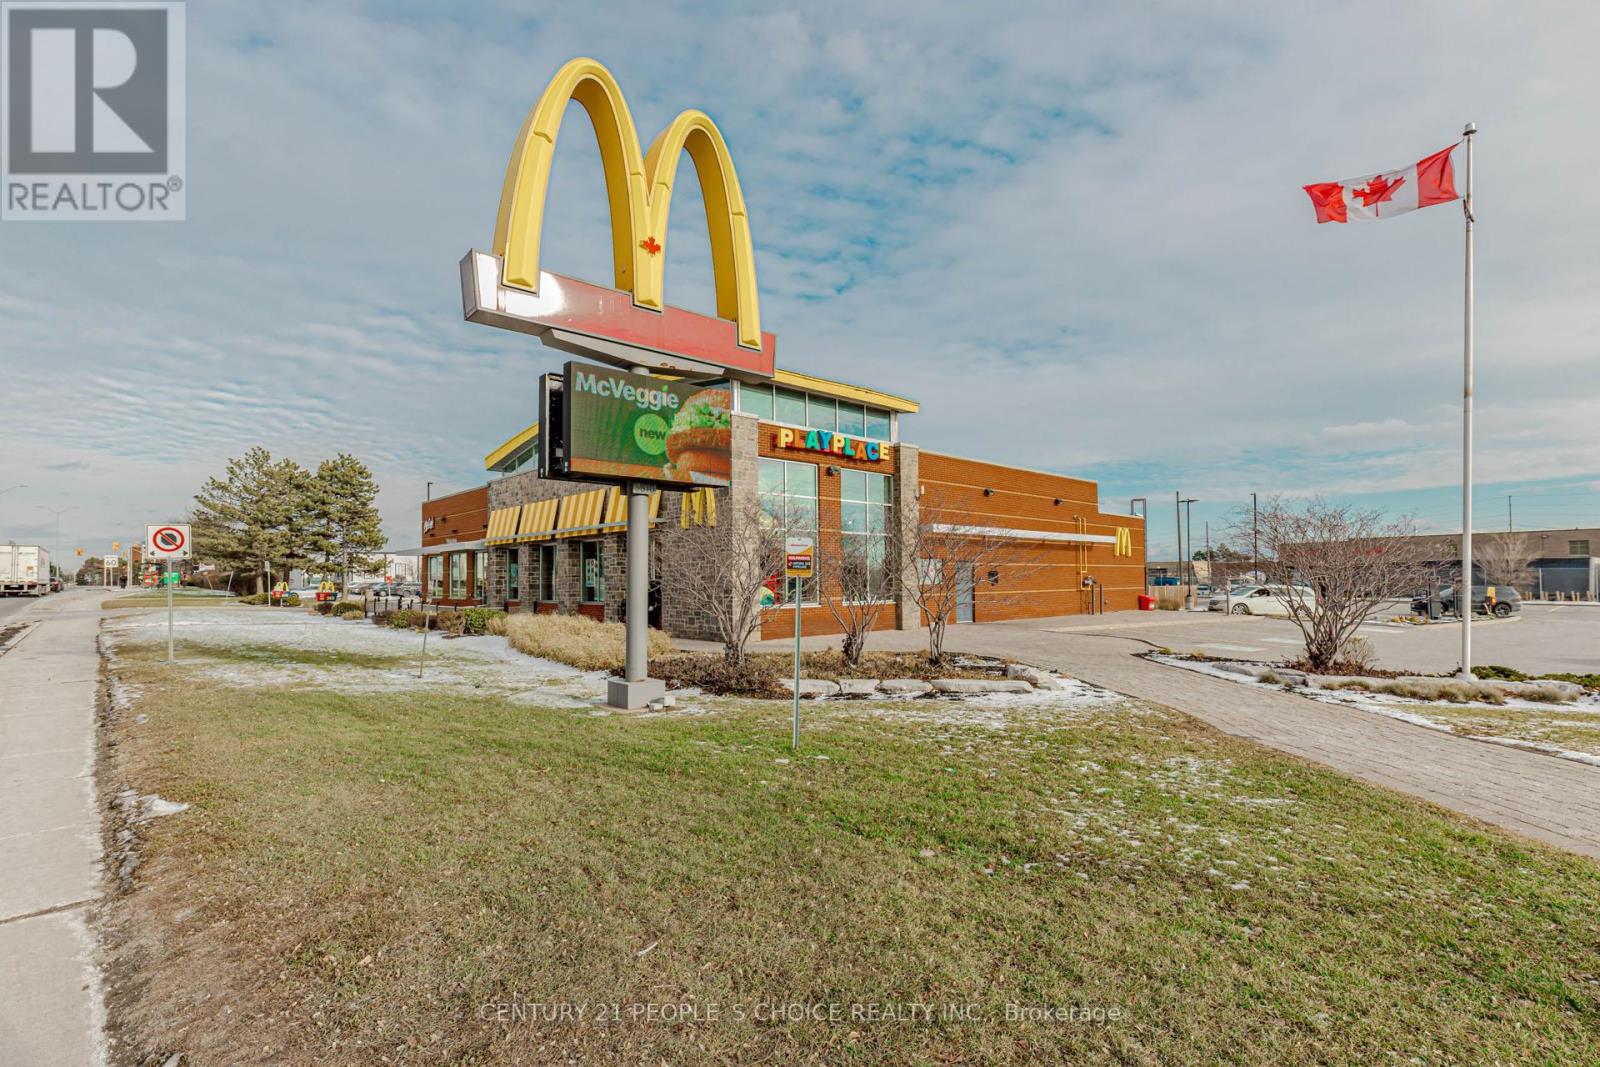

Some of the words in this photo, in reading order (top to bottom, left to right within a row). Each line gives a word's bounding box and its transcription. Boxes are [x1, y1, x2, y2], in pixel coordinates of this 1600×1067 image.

[575, 371, 680, 411] McVeggie
[640, 428, 666, 441] new
[777, 427, 891, 461] PLAYPLACE
[105, 559, 117, 567] 60
